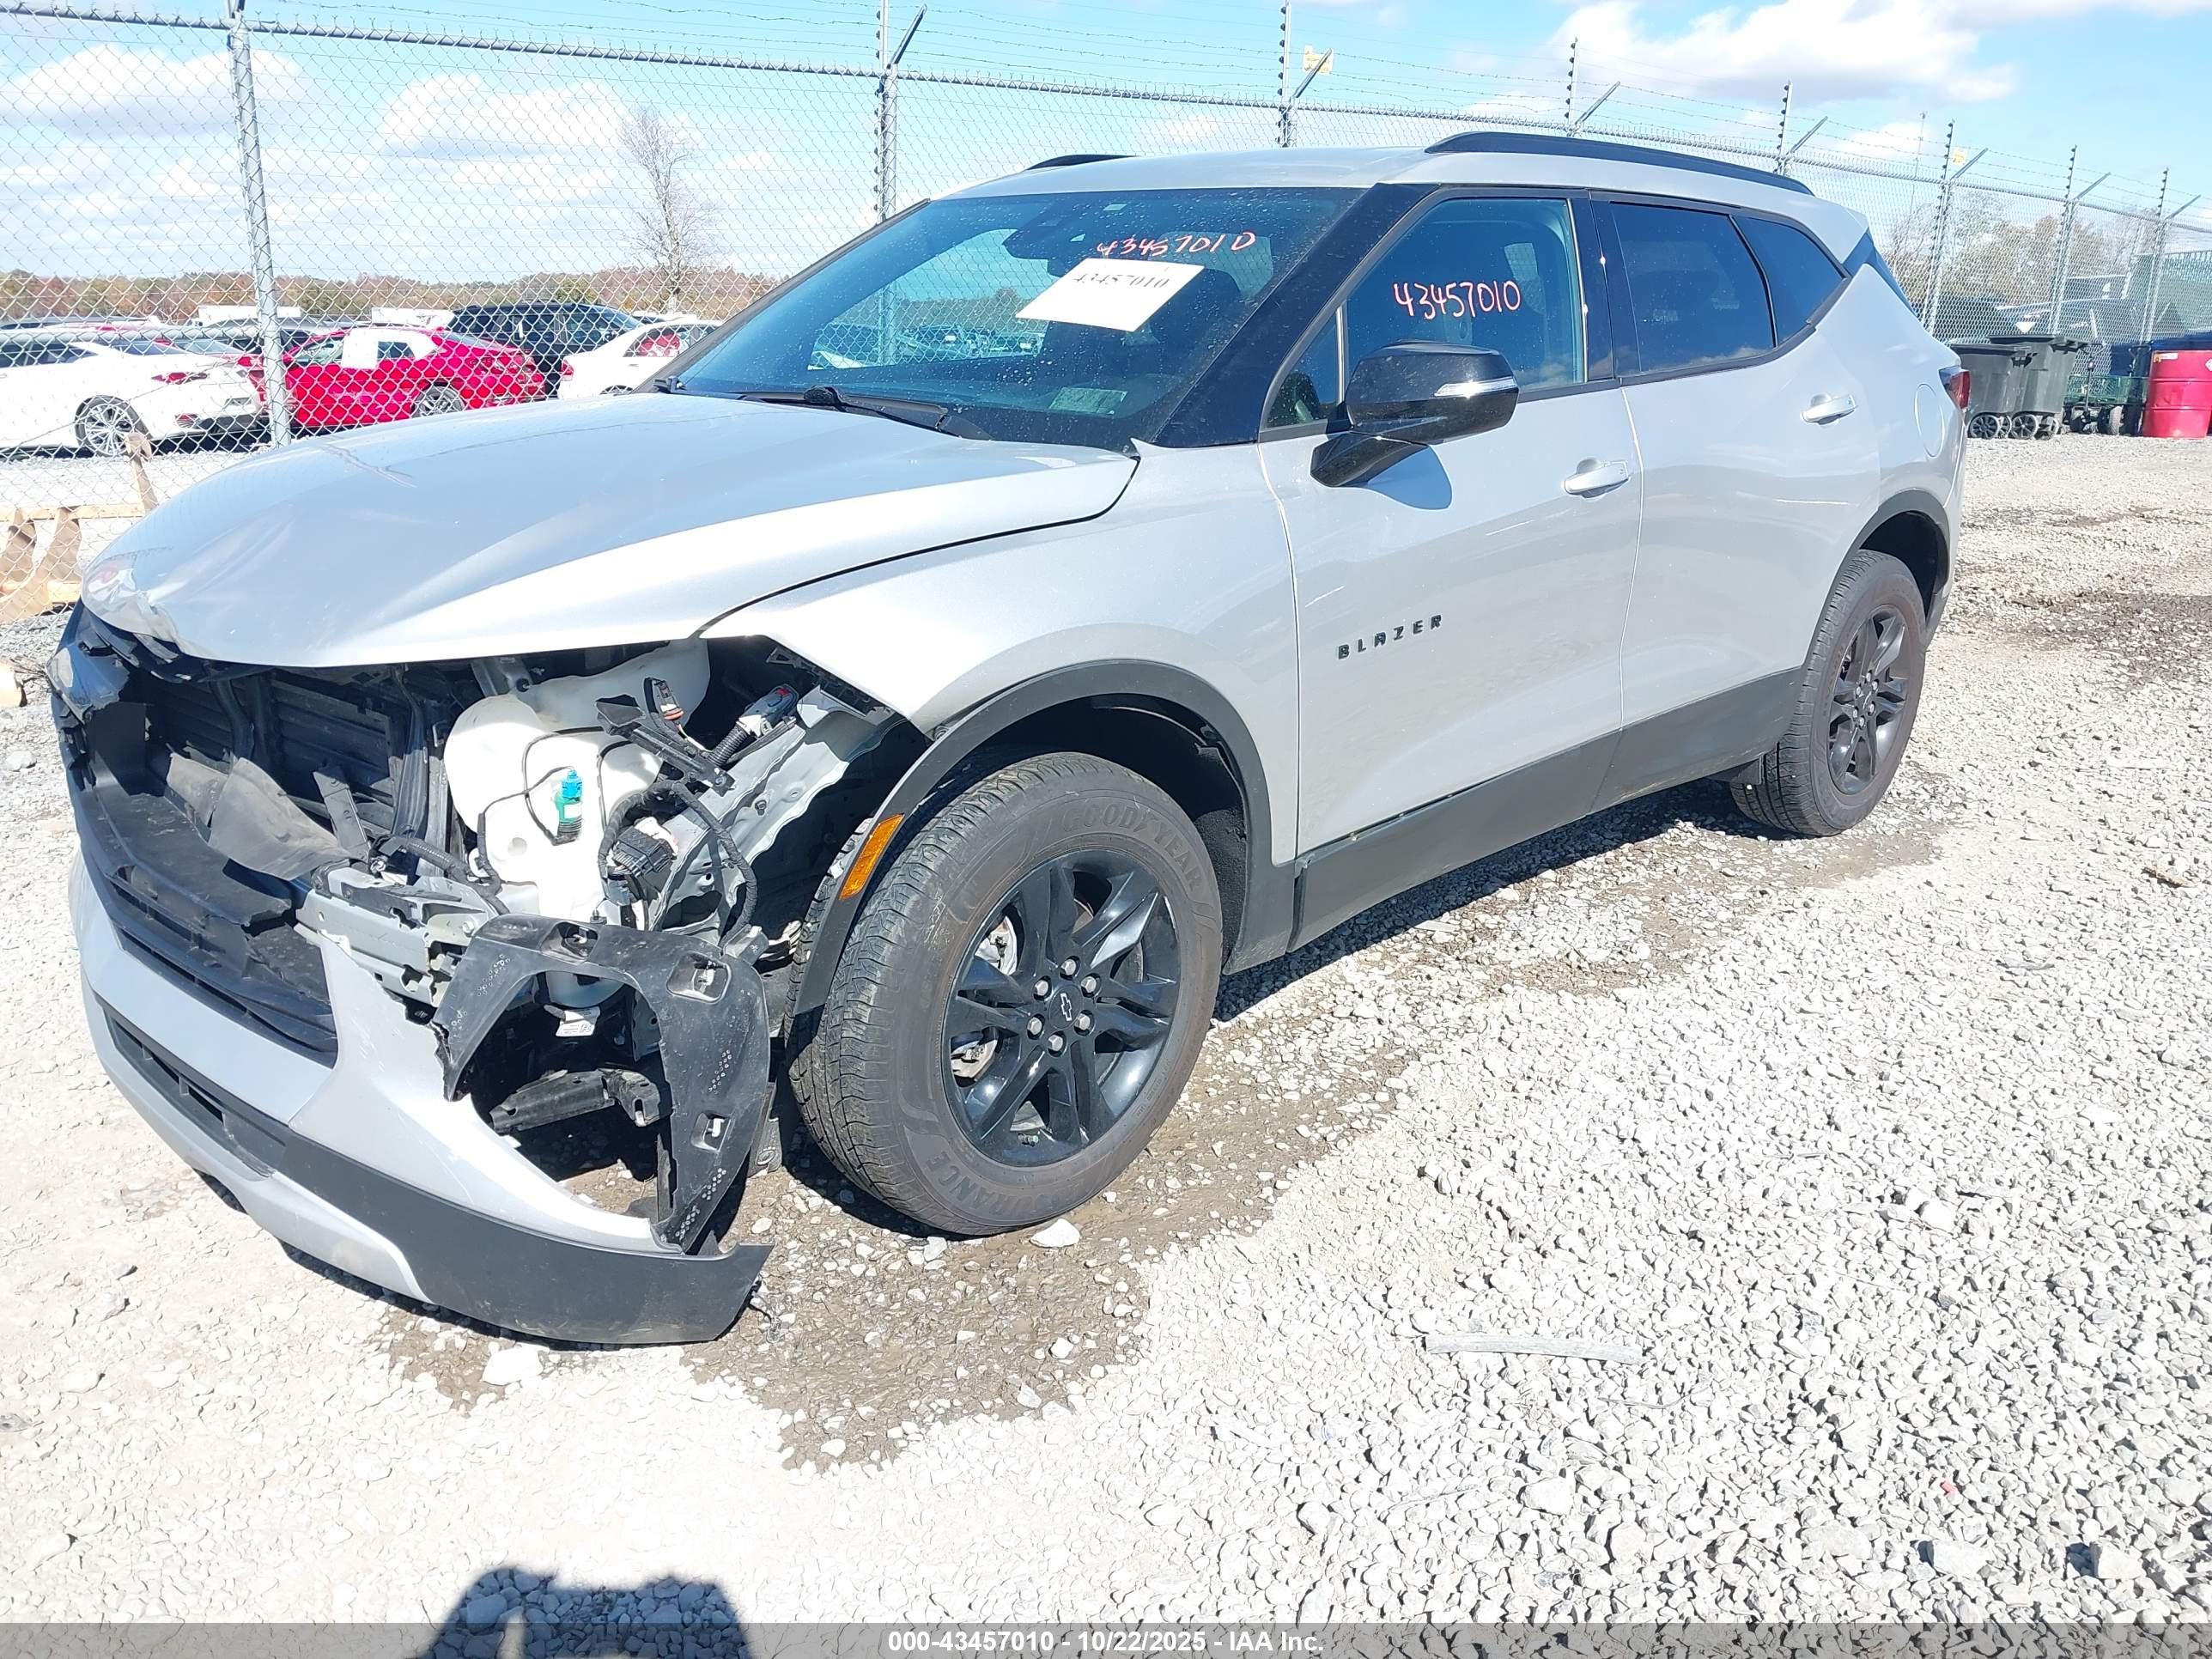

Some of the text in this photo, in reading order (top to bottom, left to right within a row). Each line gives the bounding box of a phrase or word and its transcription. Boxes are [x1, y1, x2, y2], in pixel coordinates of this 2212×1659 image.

[1097, 231, 1256, 256] 43457010
[1393, 280, 1522, 320] 43457010
[1338, 614, 1442, 659] BLAZER
